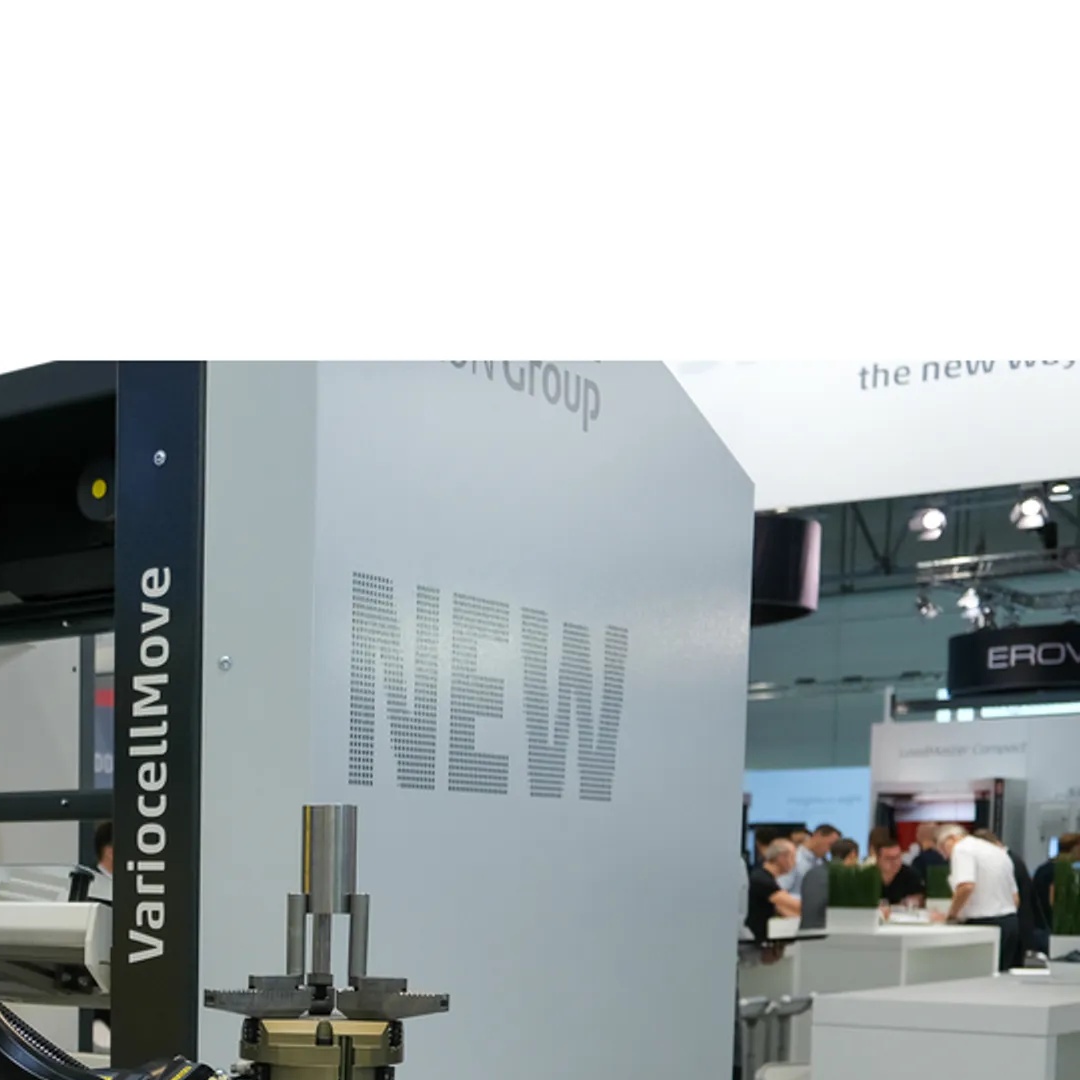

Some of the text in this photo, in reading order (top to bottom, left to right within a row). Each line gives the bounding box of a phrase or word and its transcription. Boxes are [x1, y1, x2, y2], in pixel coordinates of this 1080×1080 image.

[858, 360, 996, 390] the new
[127, 566, 171, 963] VariocellMove
[348, 571, 629, 802] NEW
